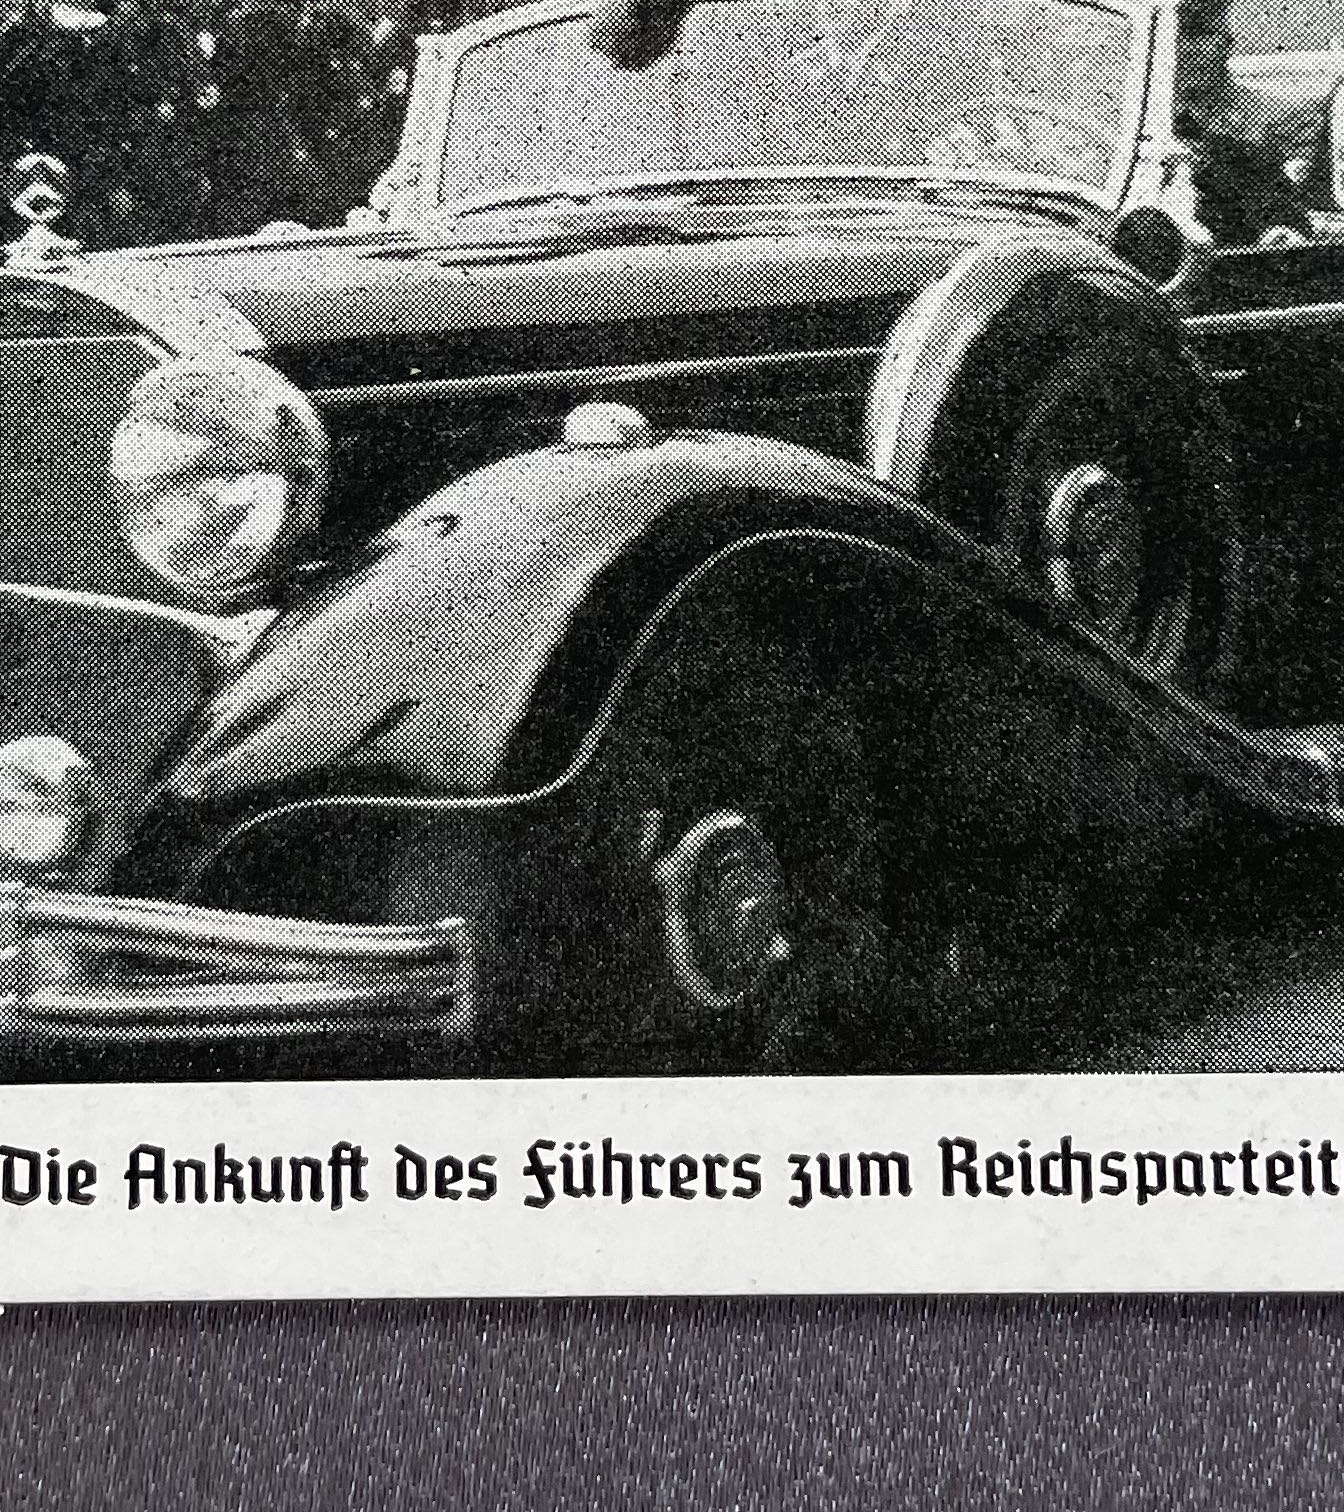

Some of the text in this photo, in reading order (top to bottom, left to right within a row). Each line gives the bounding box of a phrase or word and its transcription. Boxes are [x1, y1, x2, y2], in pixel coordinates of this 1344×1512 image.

[122, 1139, 370, 1213] Ankunft
[393, 1143, 498, 1203] des
[521, 1136, 763, 1210] Führers
[786, 1150, 914, 1210] zum
